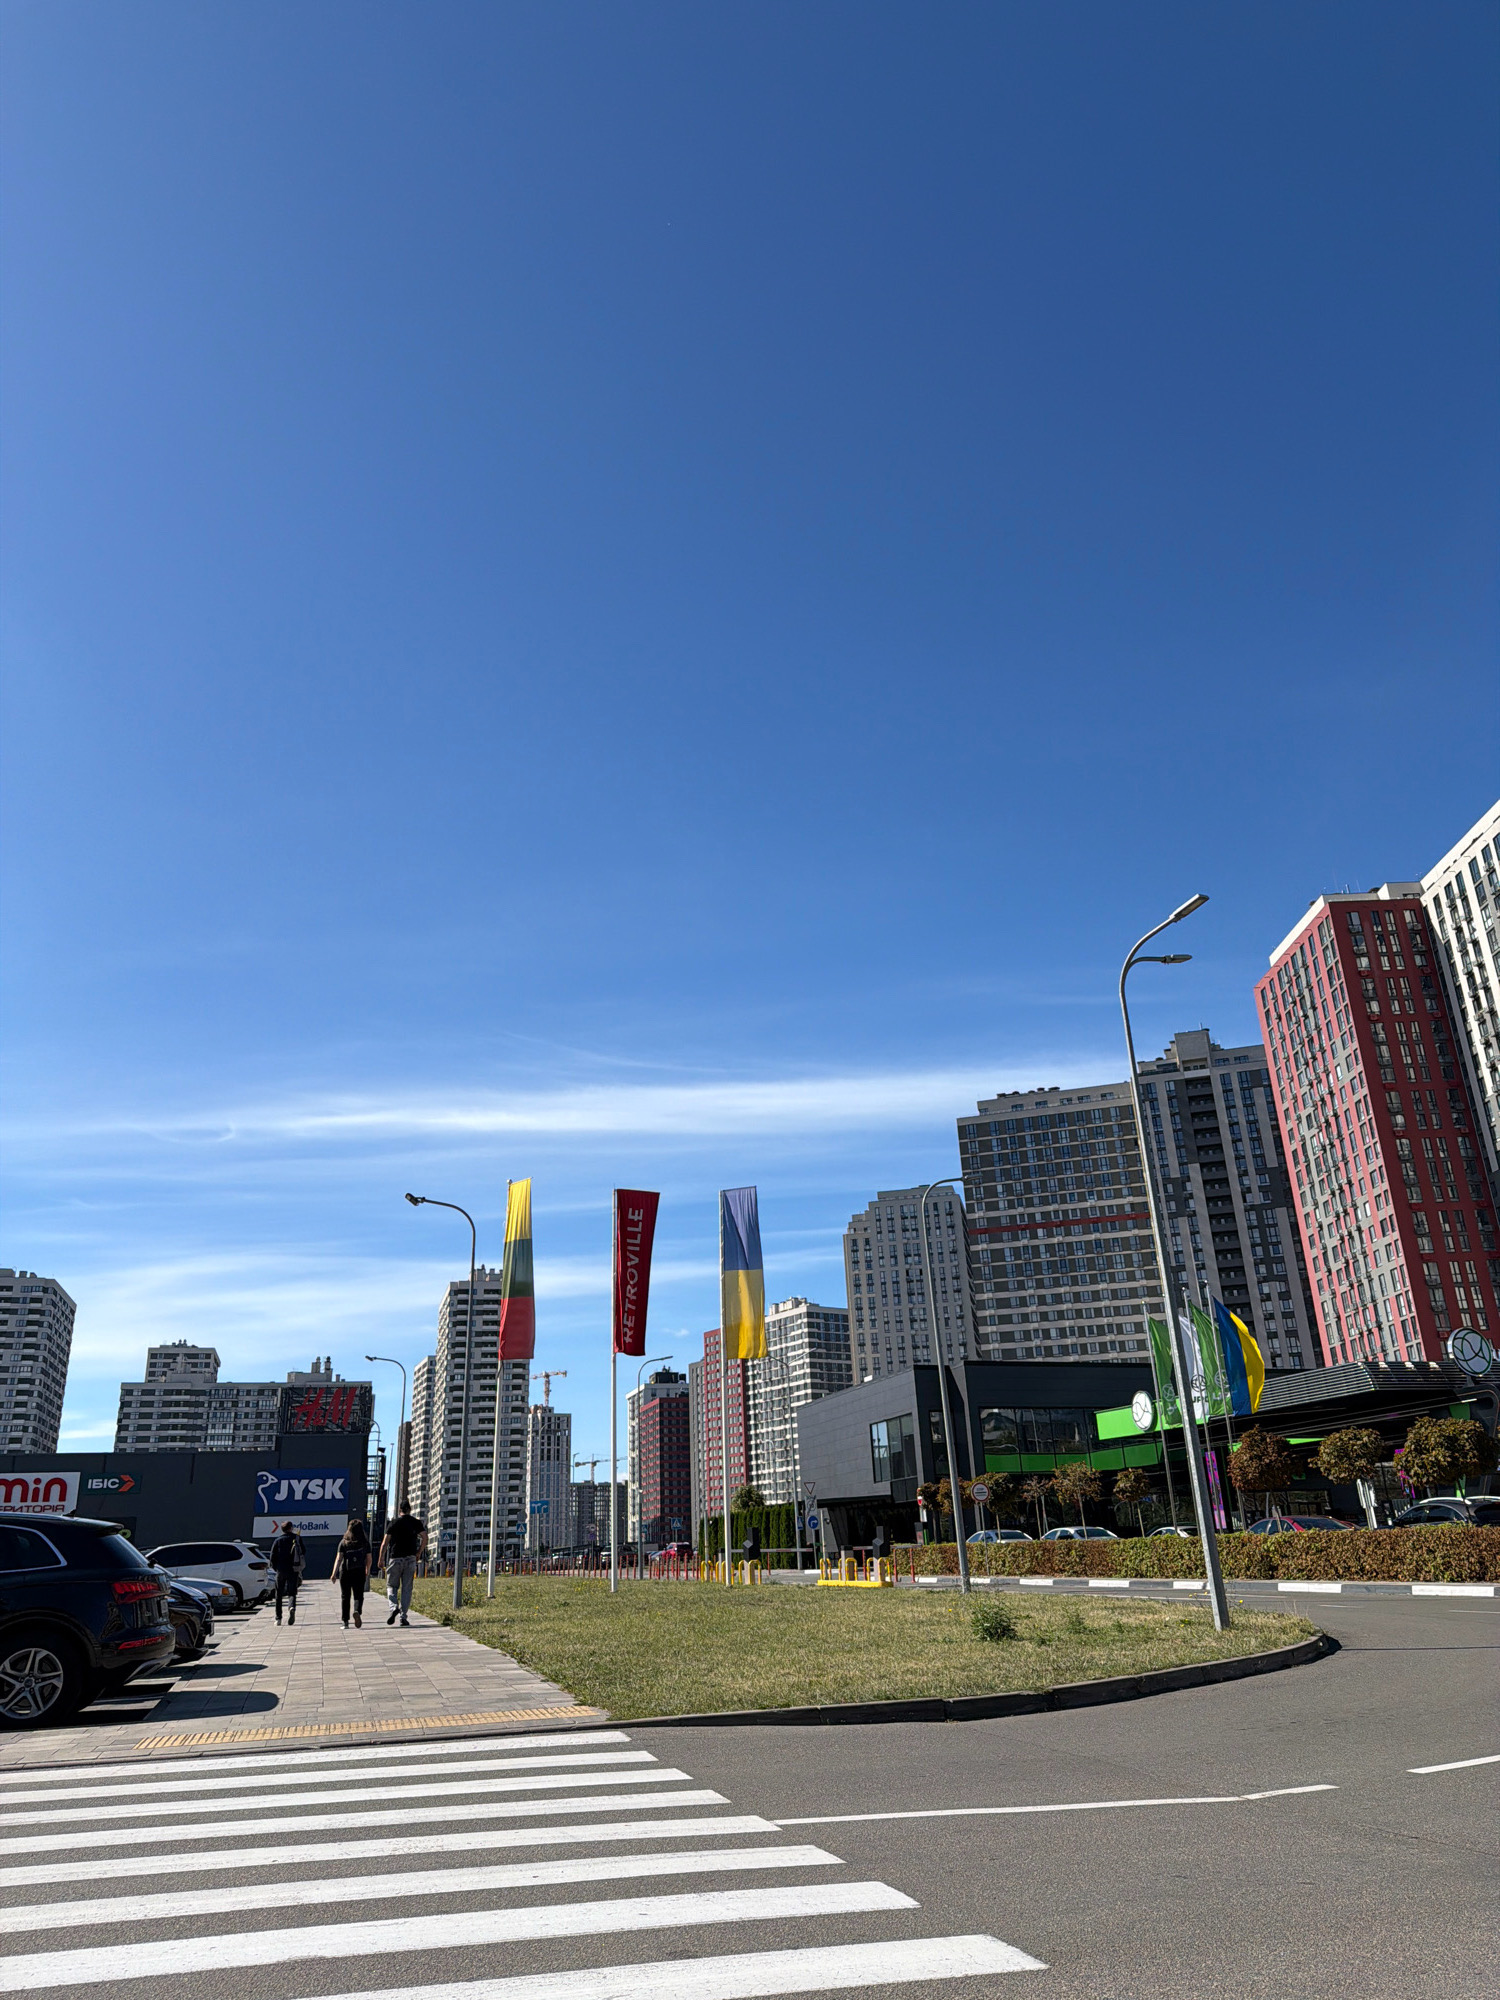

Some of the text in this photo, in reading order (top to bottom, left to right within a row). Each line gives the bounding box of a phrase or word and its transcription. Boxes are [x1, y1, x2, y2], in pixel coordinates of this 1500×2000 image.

[624, 1208, 644, 1343] RETROVILLE
[293, 1387, 358, 1428] H&M
[87, 1478, 120, 1489] ІБІС
[274, 1478, 346, 1501] JYSK
[292, 1520, 330, 1531] doBank
